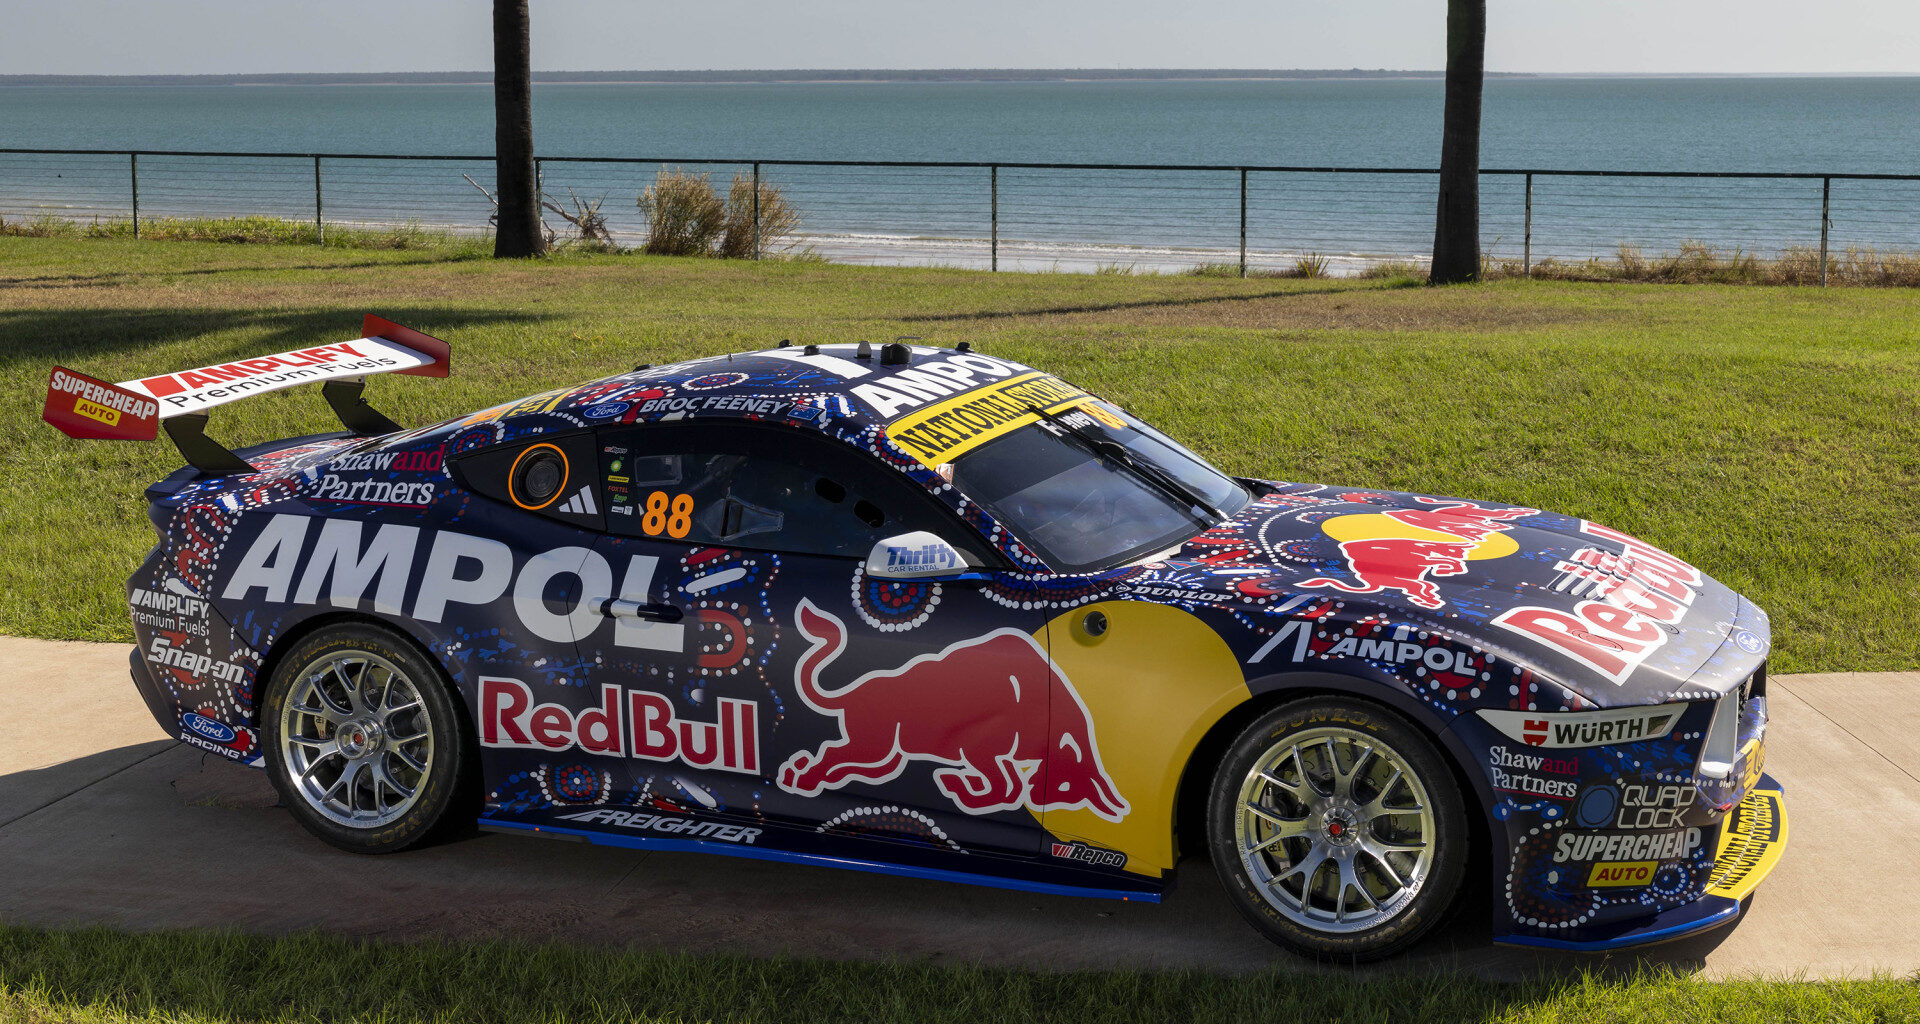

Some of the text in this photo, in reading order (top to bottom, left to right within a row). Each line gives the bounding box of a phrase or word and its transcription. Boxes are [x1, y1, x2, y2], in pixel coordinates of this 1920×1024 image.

[180, 343, 367, 388] AMPLIFY
[51, 371, 156, 420] SUPERCHEAP
[163, 355, 397, 408] Premium Fuels
[850, 352, 1032, 419] AMPOL
[78, 402, 116, 422] AUTO
[592, 404, 620, 416] Ford
[640, 397, 788, 414] BROC FEENEY
[894, 396, 1025, 459] NATIONAL
[311, 477, 435, 504] Partners
[642, 491, 694, 538] 88
[887, 544, 956, 567] Thrifty
[888, 563, 940, 573] CAR RENTAL
[221, 513, 685, 653] AMPOL
[1132, 585, 1233, 602] DUNLOP
[141, 590, 210, 619] AMPLIFY
[130, 606, 206, 637] Premium Fuels
[148, 637, 245, 684] Snap-on
[1329, 637, 1478, 676] AMPOL
[192, 715, 224, 738] Ford
[478, 676, 761, 775] Red Bull
[1271, 707, 1390, 738] DUNLOP
[1555, 717, 1642, 744] WÜRTH
[180, 732, 240, 758] RACING
[1491, 767, 1577, 798] Partners
[1622, 785, 1697, 807] QUAD
[590, 808, 763, 844] FREIGHTER
[1617, 808, 1690, 829] LOCK
[1070, 843, 1126, 867] Repco
[1553, 827, 1702, 863] SUPERCHEAP
[1595, 867, 1649, 882] AUTO
